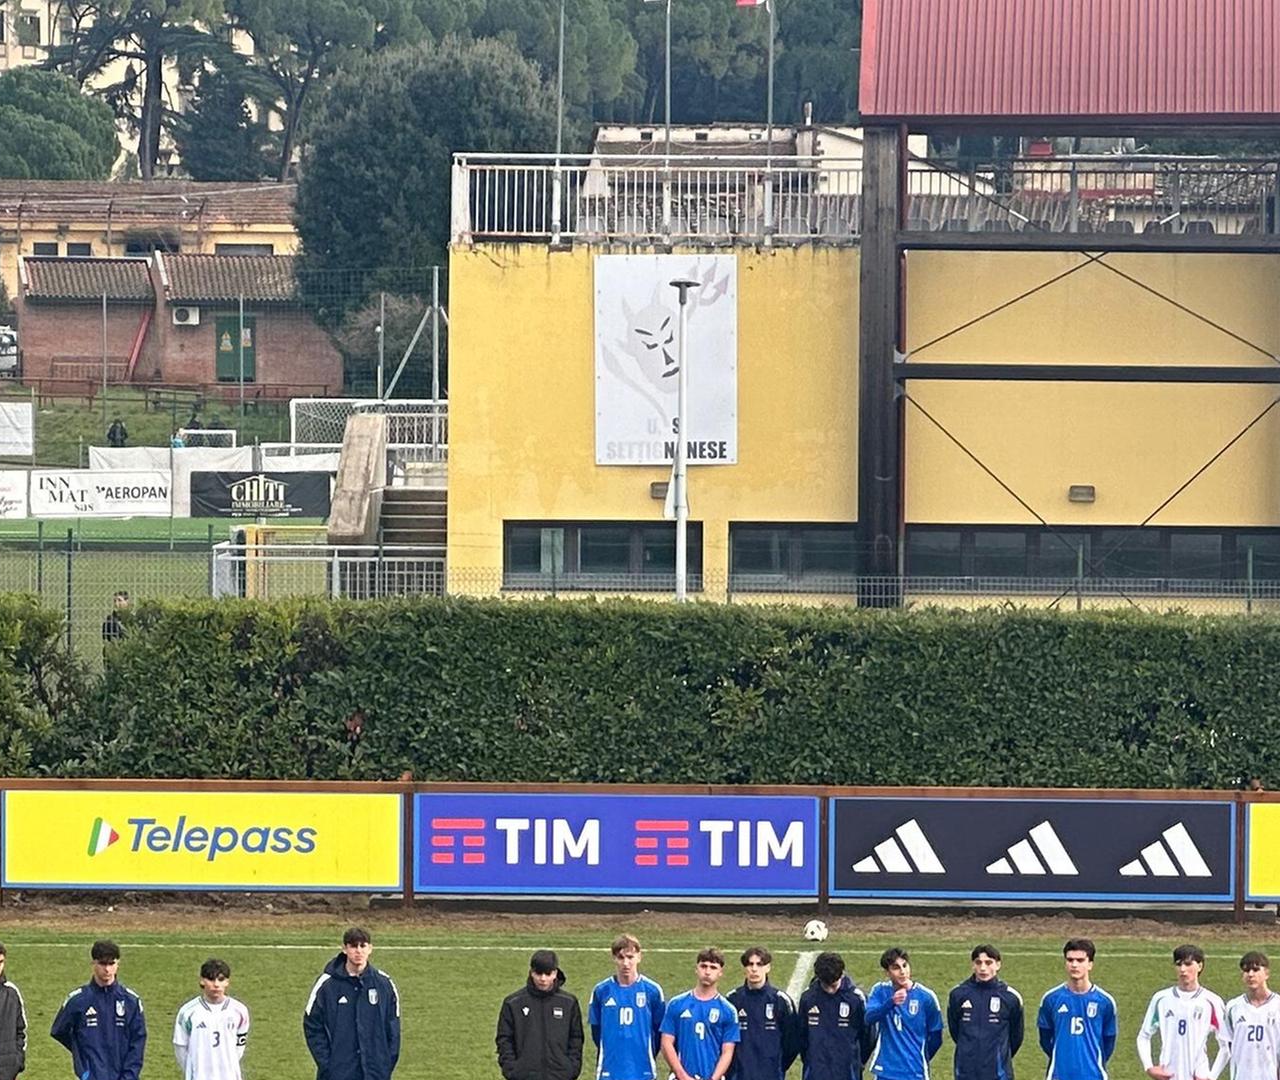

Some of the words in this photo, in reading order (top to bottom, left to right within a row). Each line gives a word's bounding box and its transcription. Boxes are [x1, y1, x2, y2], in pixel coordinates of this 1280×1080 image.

[606, 440, 727, 460] SETTIGNNESE
[39, 476, 70, 490] INN
[231, 479, 285, 501] CHITI
[48, 490, 88, 503] MAT
[104, 486, 168, 499] AEROPAN
[127, 815, 318, 862] Telepass
[495, 818, 600, 865] TIM
[698, 820, 804, 867] TIM
[619, 1007, 633, 1025] 10
[695, 1021, 705, 1040] 9
[1071, 1016, 1085, 1035] 15
[1178, 1019, 1186, 1036] 8
[1247, 1025, 1264, 1042] 20
[212, 1031, 220, 1047] 3
